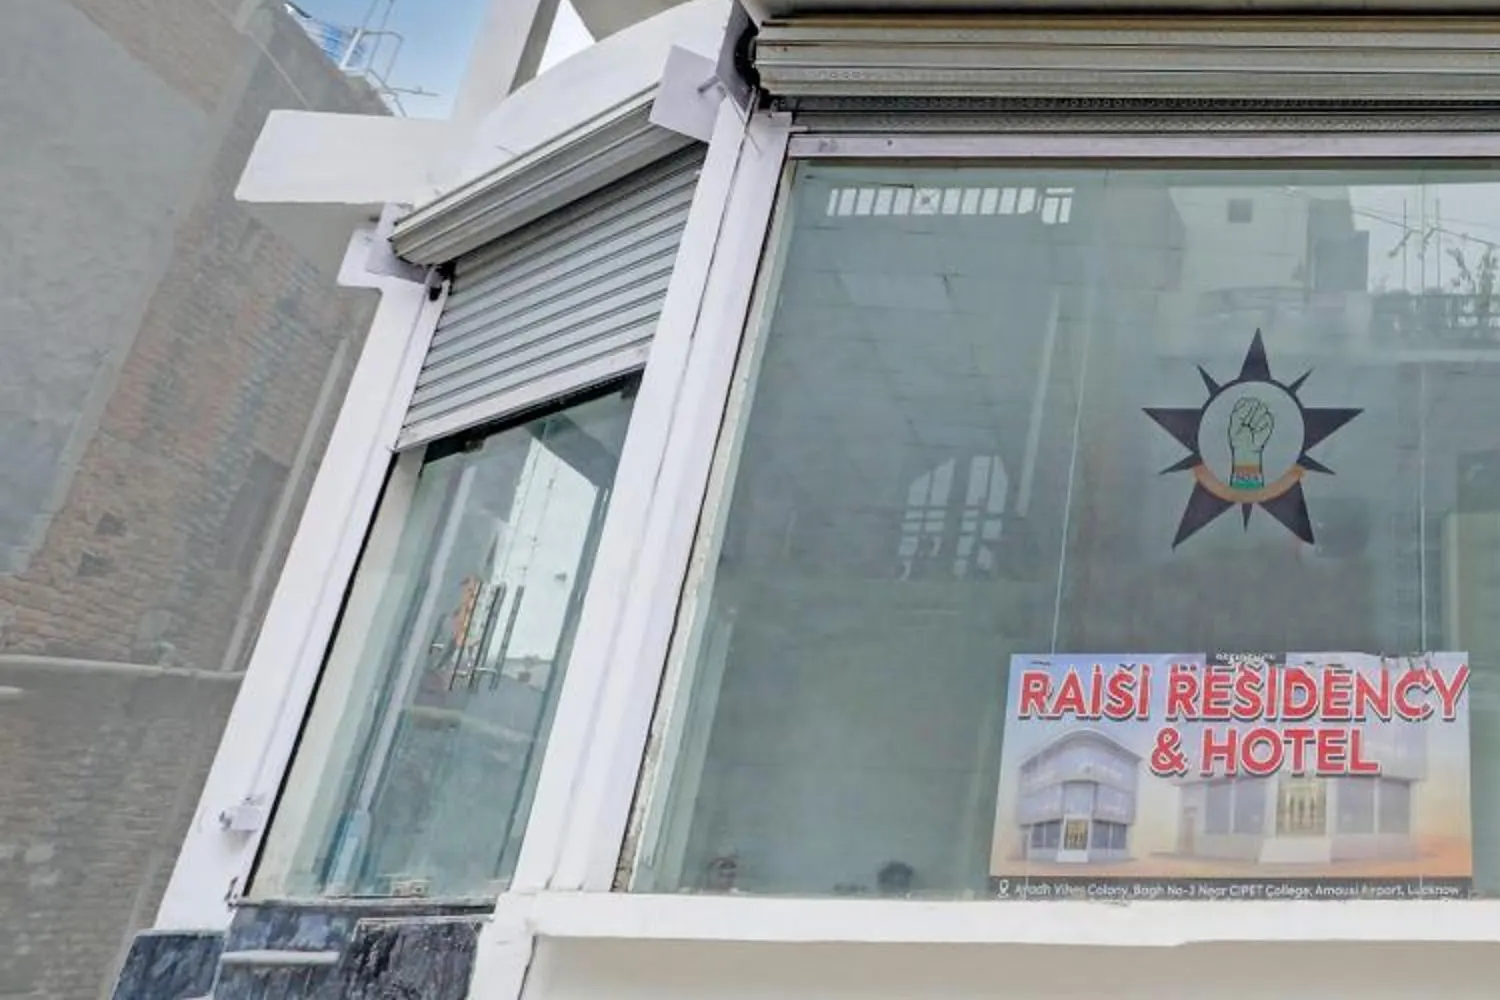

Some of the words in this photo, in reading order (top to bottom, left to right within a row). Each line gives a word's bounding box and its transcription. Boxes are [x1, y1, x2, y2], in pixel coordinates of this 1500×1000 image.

[1017, 663, 1152, 720] RAISI
[1164, 662, 1472, 721] RESIDENCY
[1149, 726, 1189, 777] &
[1199, 727, 1383, 777] HOTEL
